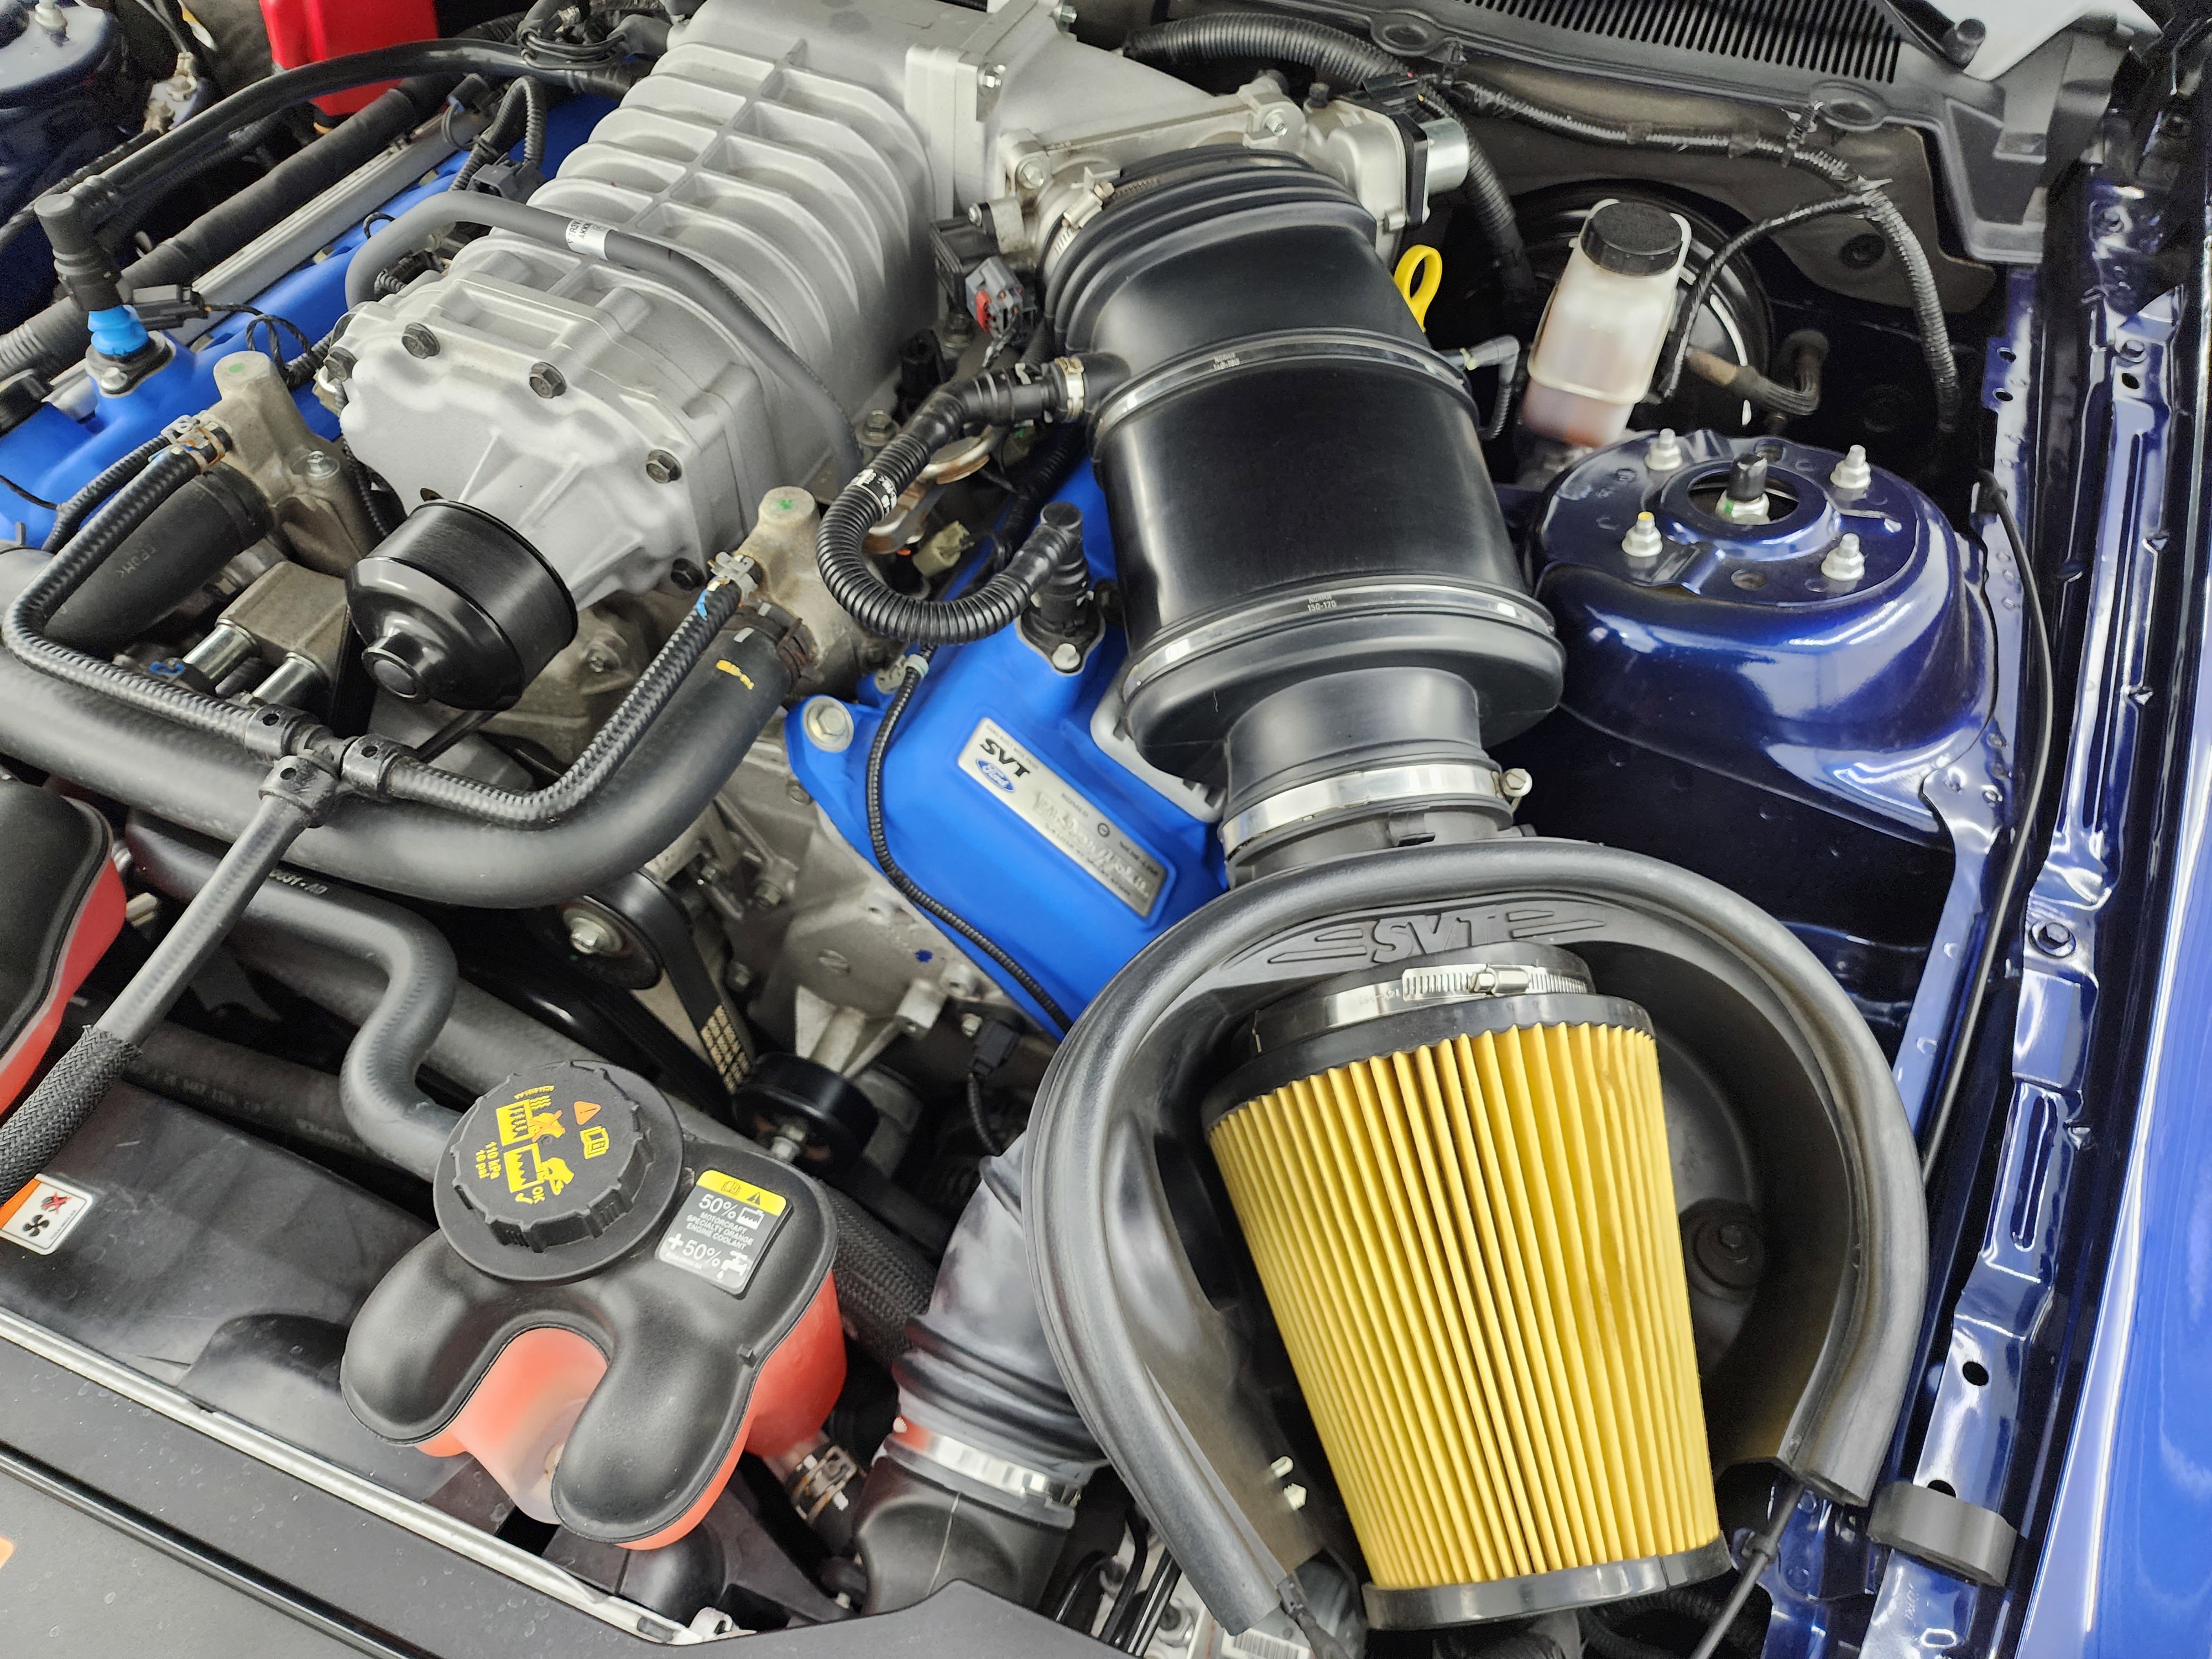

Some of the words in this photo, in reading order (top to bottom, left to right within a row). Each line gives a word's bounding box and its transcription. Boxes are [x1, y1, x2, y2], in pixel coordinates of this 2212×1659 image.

[979, 738, 1030, 778] SVT
[982, 763, 1010, 788] Ford
[1371, 907, 1496, 964] SVT
[485, 1141, 499, 1159] 110
[532, 1186, 546, 1204] OK
[698, 1193, 738, 1219] 50%
[685, 1214, 724, 1233] SPECIALTY
[723, 1228, 754, 1246] ORANGE
[686, 1222, 714, 1238] ENGINE
[711, 1232, 747, 1250] COOLANT
[700, 1211, 748, 1235] MOTORCRAFT
